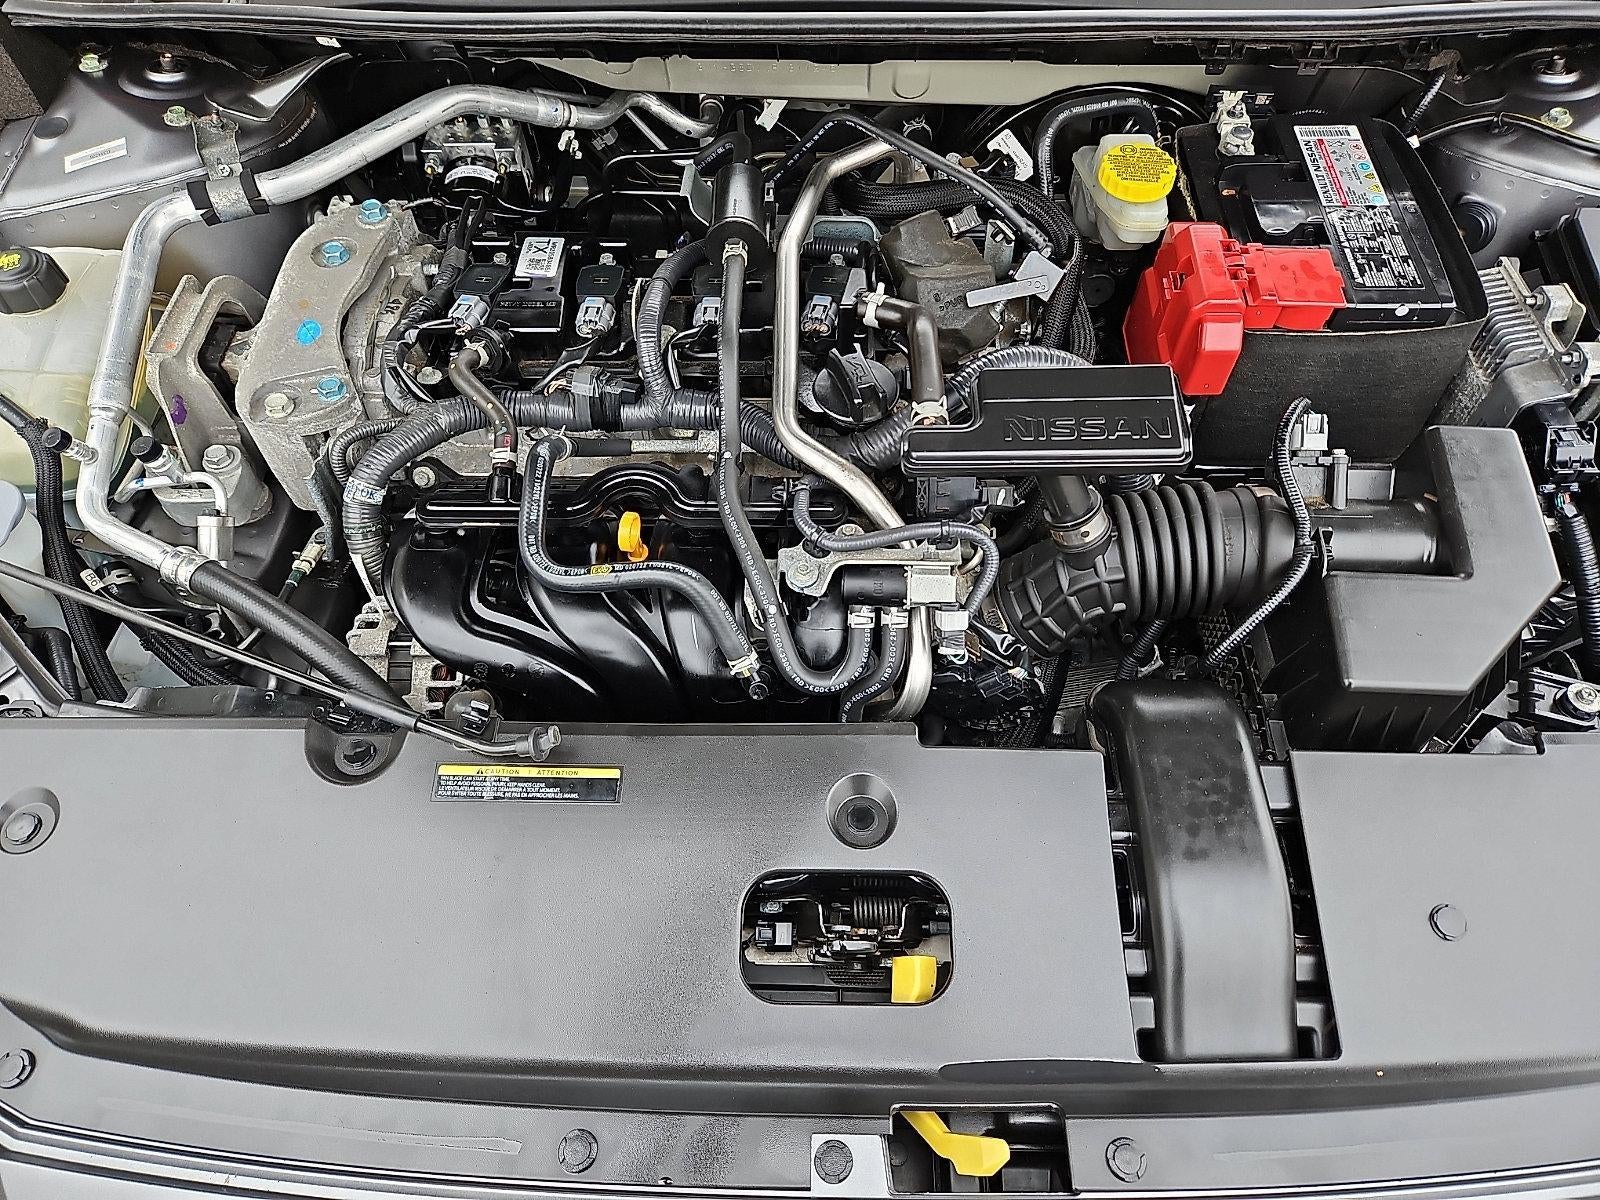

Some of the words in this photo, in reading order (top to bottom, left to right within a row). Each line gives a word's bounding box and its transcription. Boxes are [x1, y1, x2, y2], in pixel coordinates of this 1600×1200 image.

[1303, 139, 1321, 172] NISSAN
[1315, 173, 1335, 204] RENAULT
[1004, 415, 1172, 441] NISSAN
